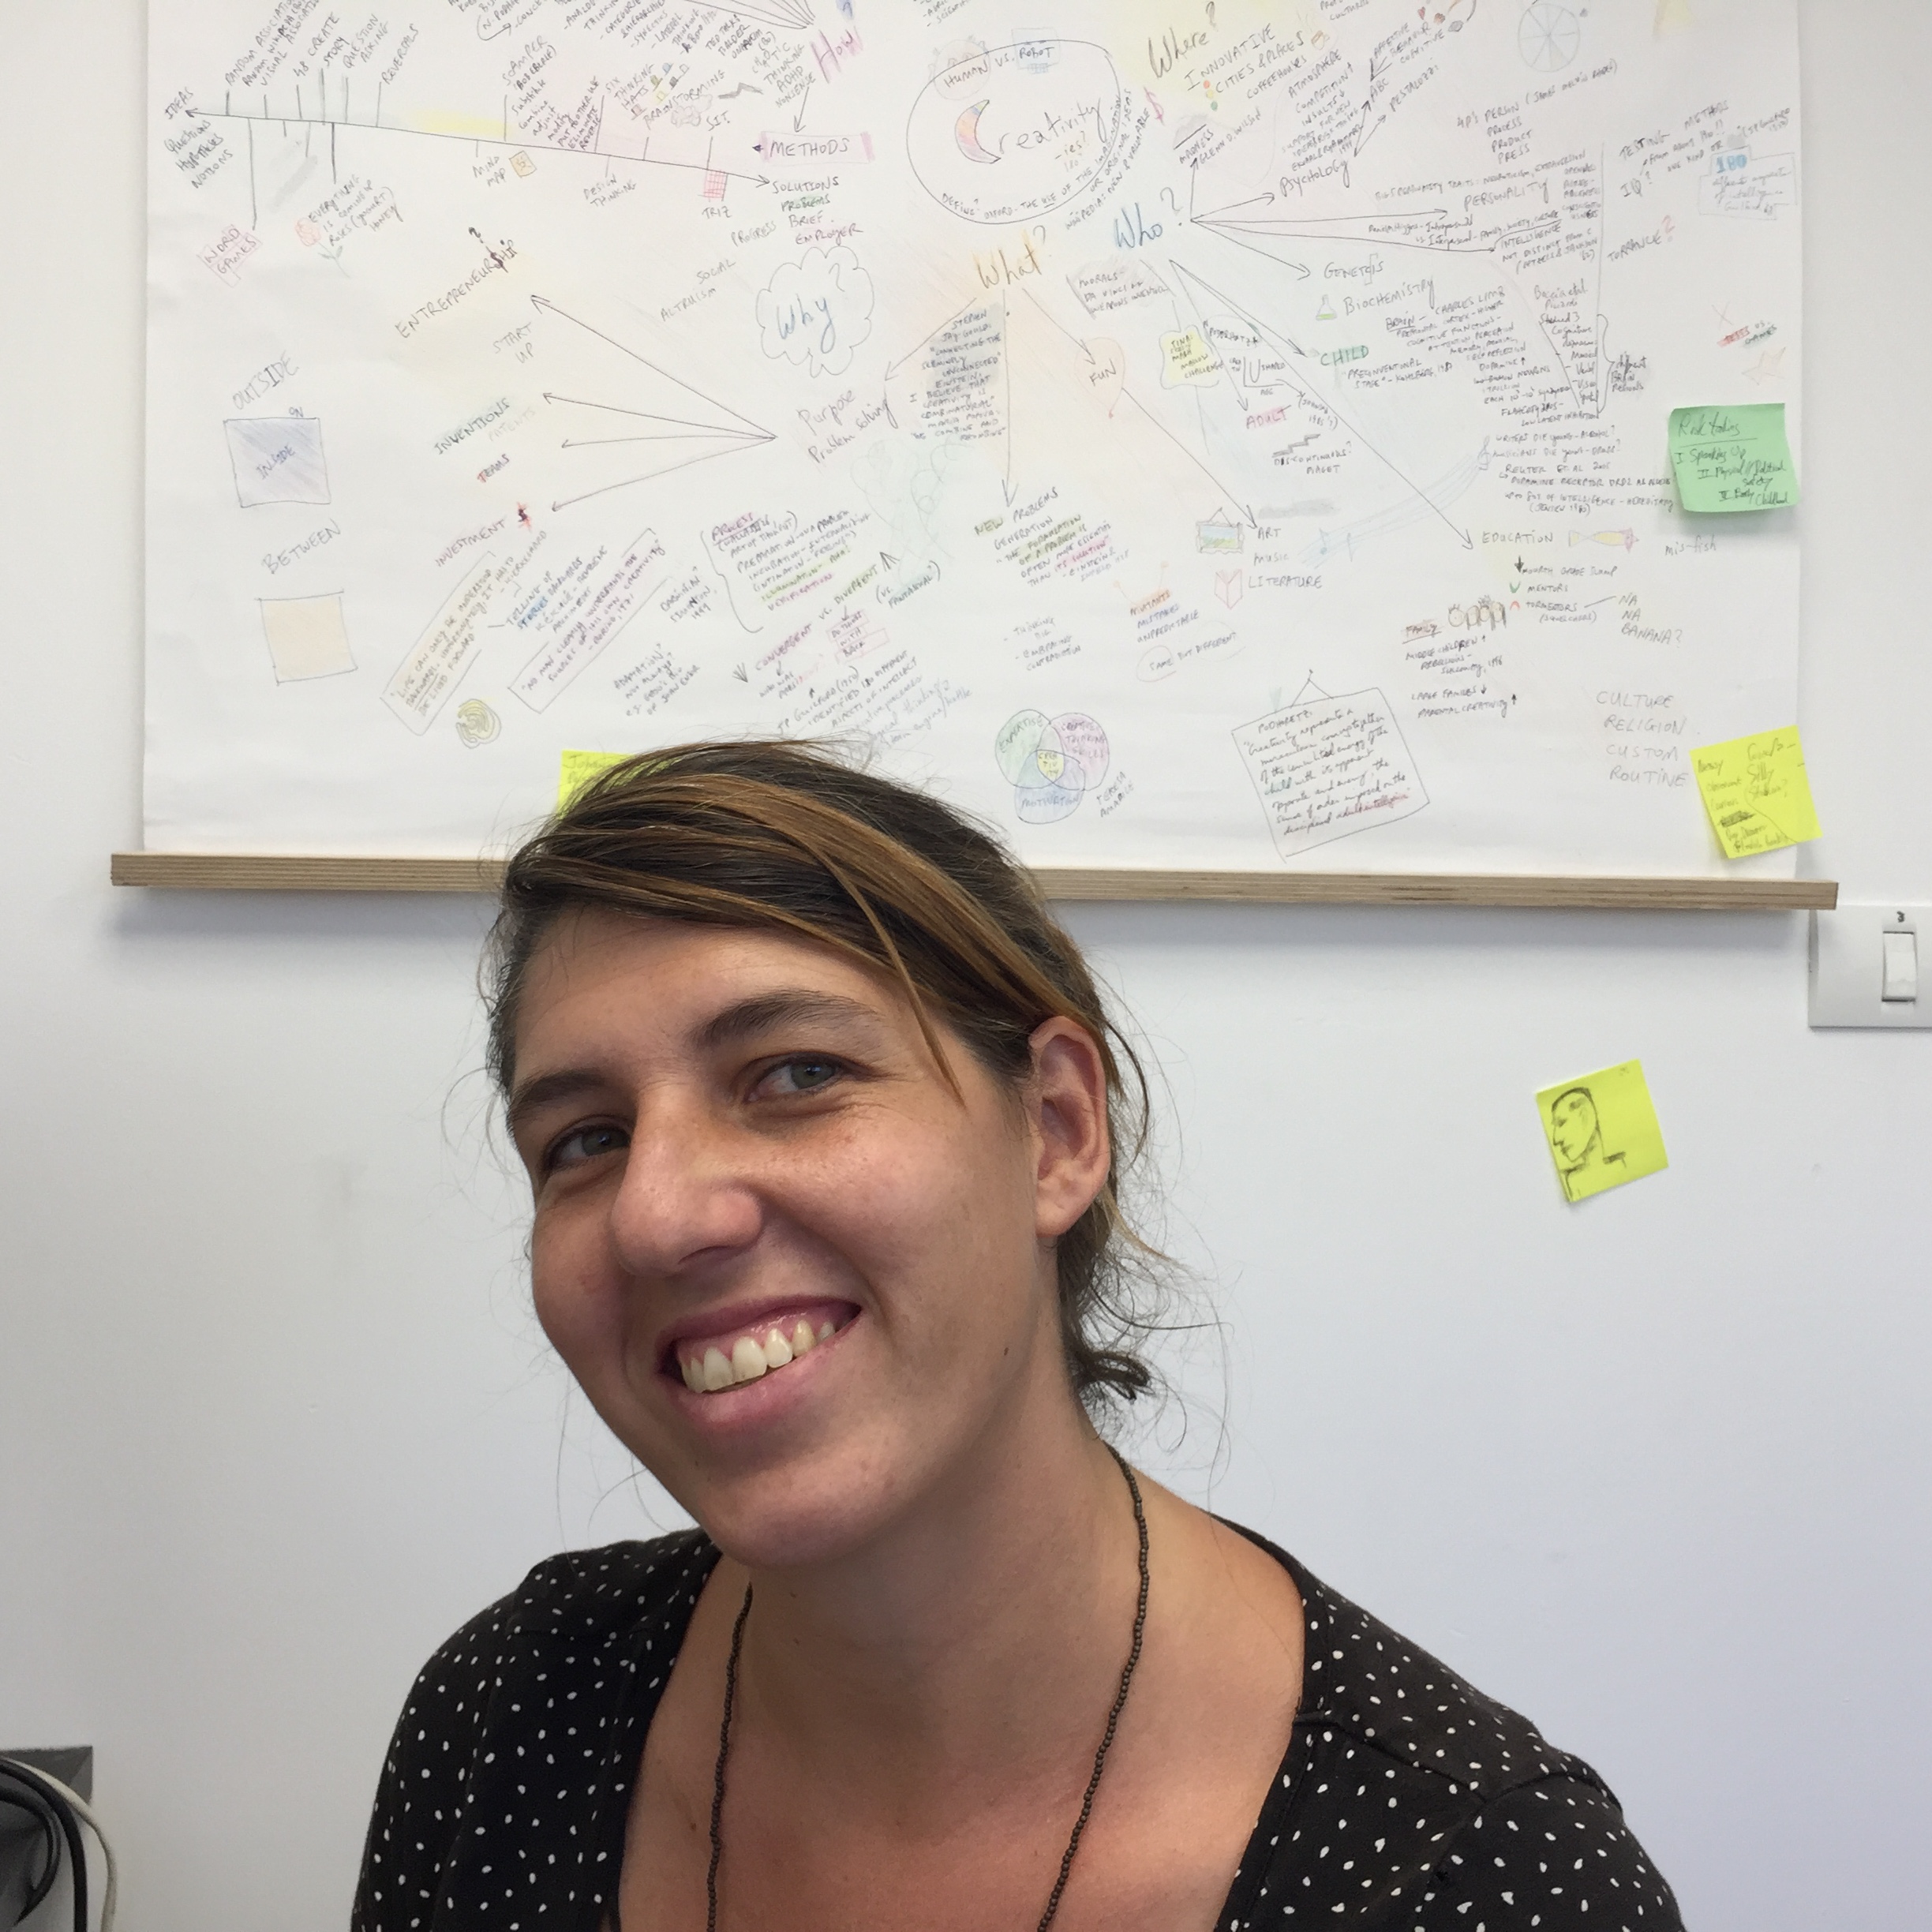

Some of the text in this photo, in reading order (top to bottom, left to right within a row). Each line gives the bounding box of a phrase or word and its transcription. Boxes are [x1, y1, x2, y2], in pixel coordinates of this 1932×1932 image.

[308, 11, 340, 56] CREATE
[323, 36, 350, 68] STORY
[944, 60, 988, 88] HUMAN
[1019, 46, 1054, 59] ROBOT
[1215, 63, 1255, 94] CITIES
[769, 137, 850, 158] METHODS
[772, 176, 839, 193] SOLUTIONS
[492, 323, 532, 354] START
[515, 343, 534, 363] UP
[1320, 345, 1369, 366] CHILD
[232, 350, 300, 410] OUTSIDE
[1089, 358, 1116, 387] FUN
[434, 398, 510, 455] INVENTIONS
[1245, 406, 1286, 429] ADULT
[974, 487, 1058, 536] NEW PROBLEMS
[260, 519, 342, 575] BETWEEN
[435, 516, 507, 567] INVESTMENT
[1258, 527, 1281, 541] ART
[1248, 575, 1323, 589] LITERATURE
[1596, 691, 1674, 709] CULTURE
[1604, 713, 1687, 735] RELIGION
[1605, 744, 1678, 762] CUSTOM
